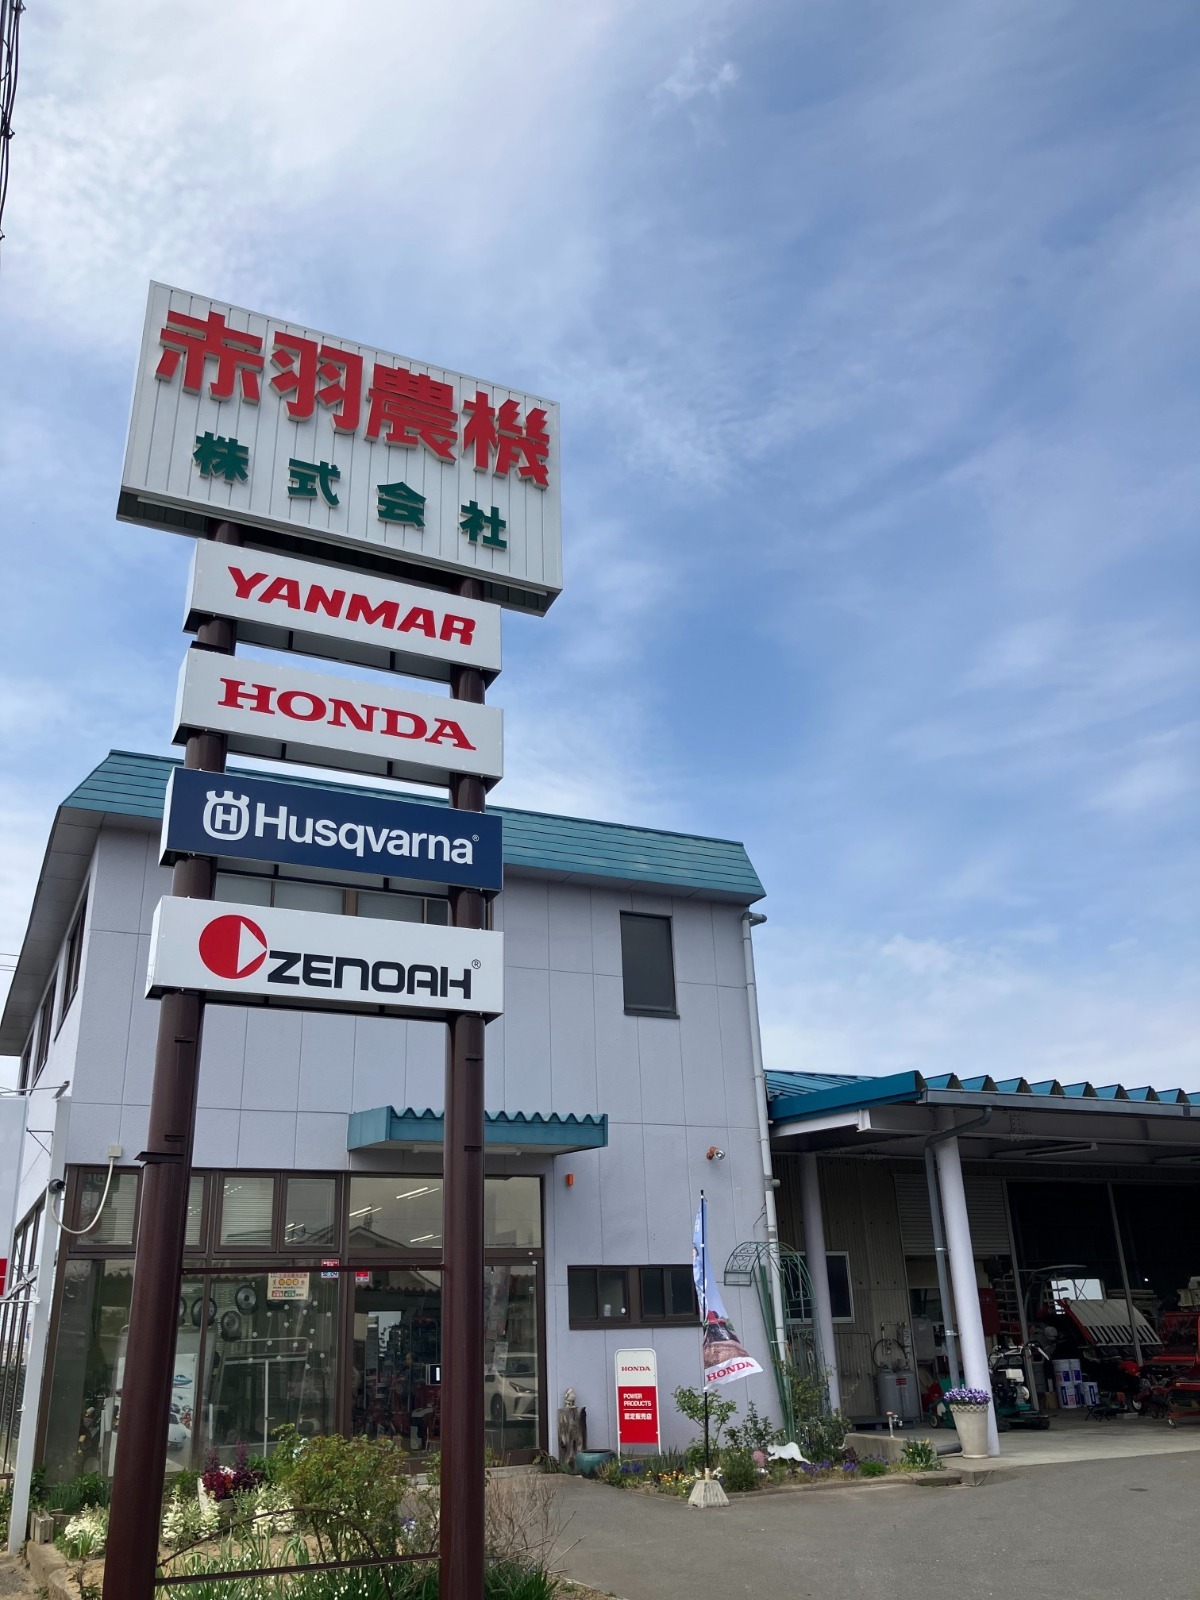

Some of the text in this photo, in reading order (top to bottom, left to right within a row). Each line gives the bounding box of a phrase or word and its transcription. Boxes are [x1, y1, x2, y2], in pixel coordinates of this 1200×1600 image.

[155, 311, 550, 489] 赤羽農機
[193, 431, 507, 550] 株式会社
[227, 566, 476, 645] YANMAR
[218, 677, 476, 751] HONDA
[254, 802, 473, 866] Husqvarna
[267, 950, 472, 999] ZENOAH
[706, 1361, 754, 1381] HONDA
